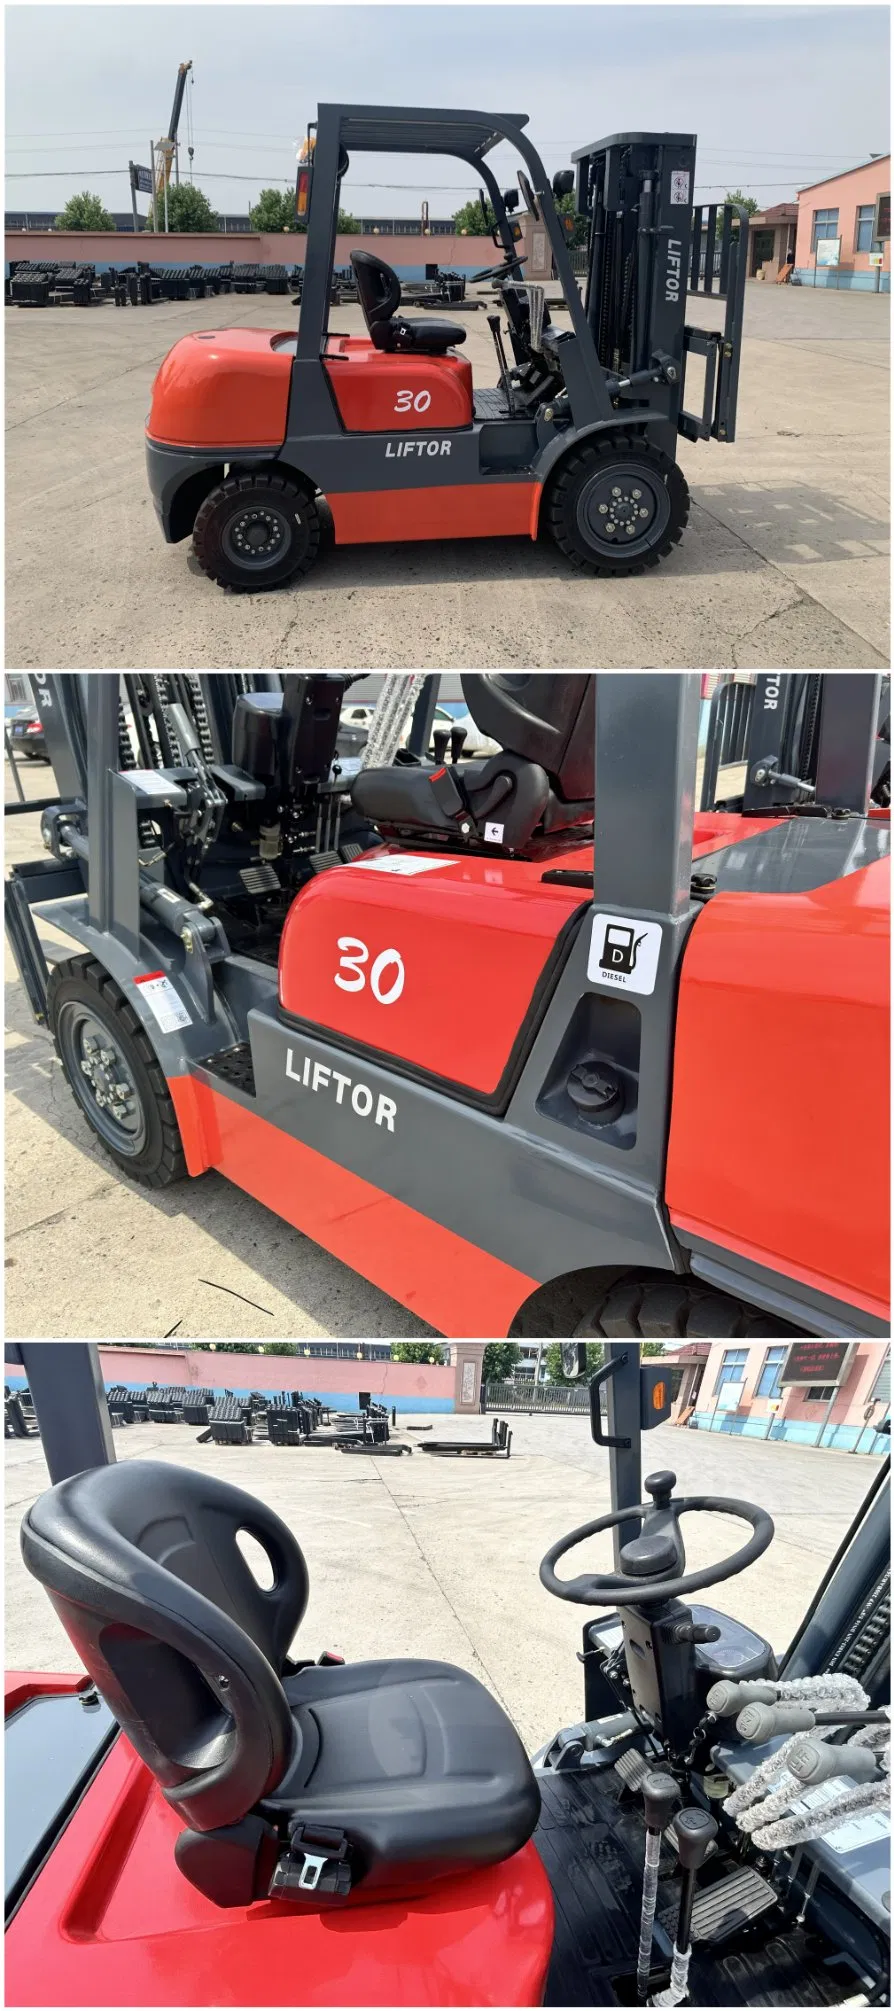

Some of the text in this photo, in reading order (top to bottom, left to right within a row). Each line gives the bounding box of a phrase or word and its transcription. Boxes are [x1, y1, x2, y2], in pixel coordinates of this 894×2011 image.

[665, 239, 682, 303] LIFTOR
[393, 389, 432, 413] 30
[385, 440, 452, 458] LIFTOR
[611, 948, 624, 963] D
[334, 936, 405, 1005] 30
[601, 971, 627, 983] DIESEL
[285, 1048, 398, 1133] LIFTOR
